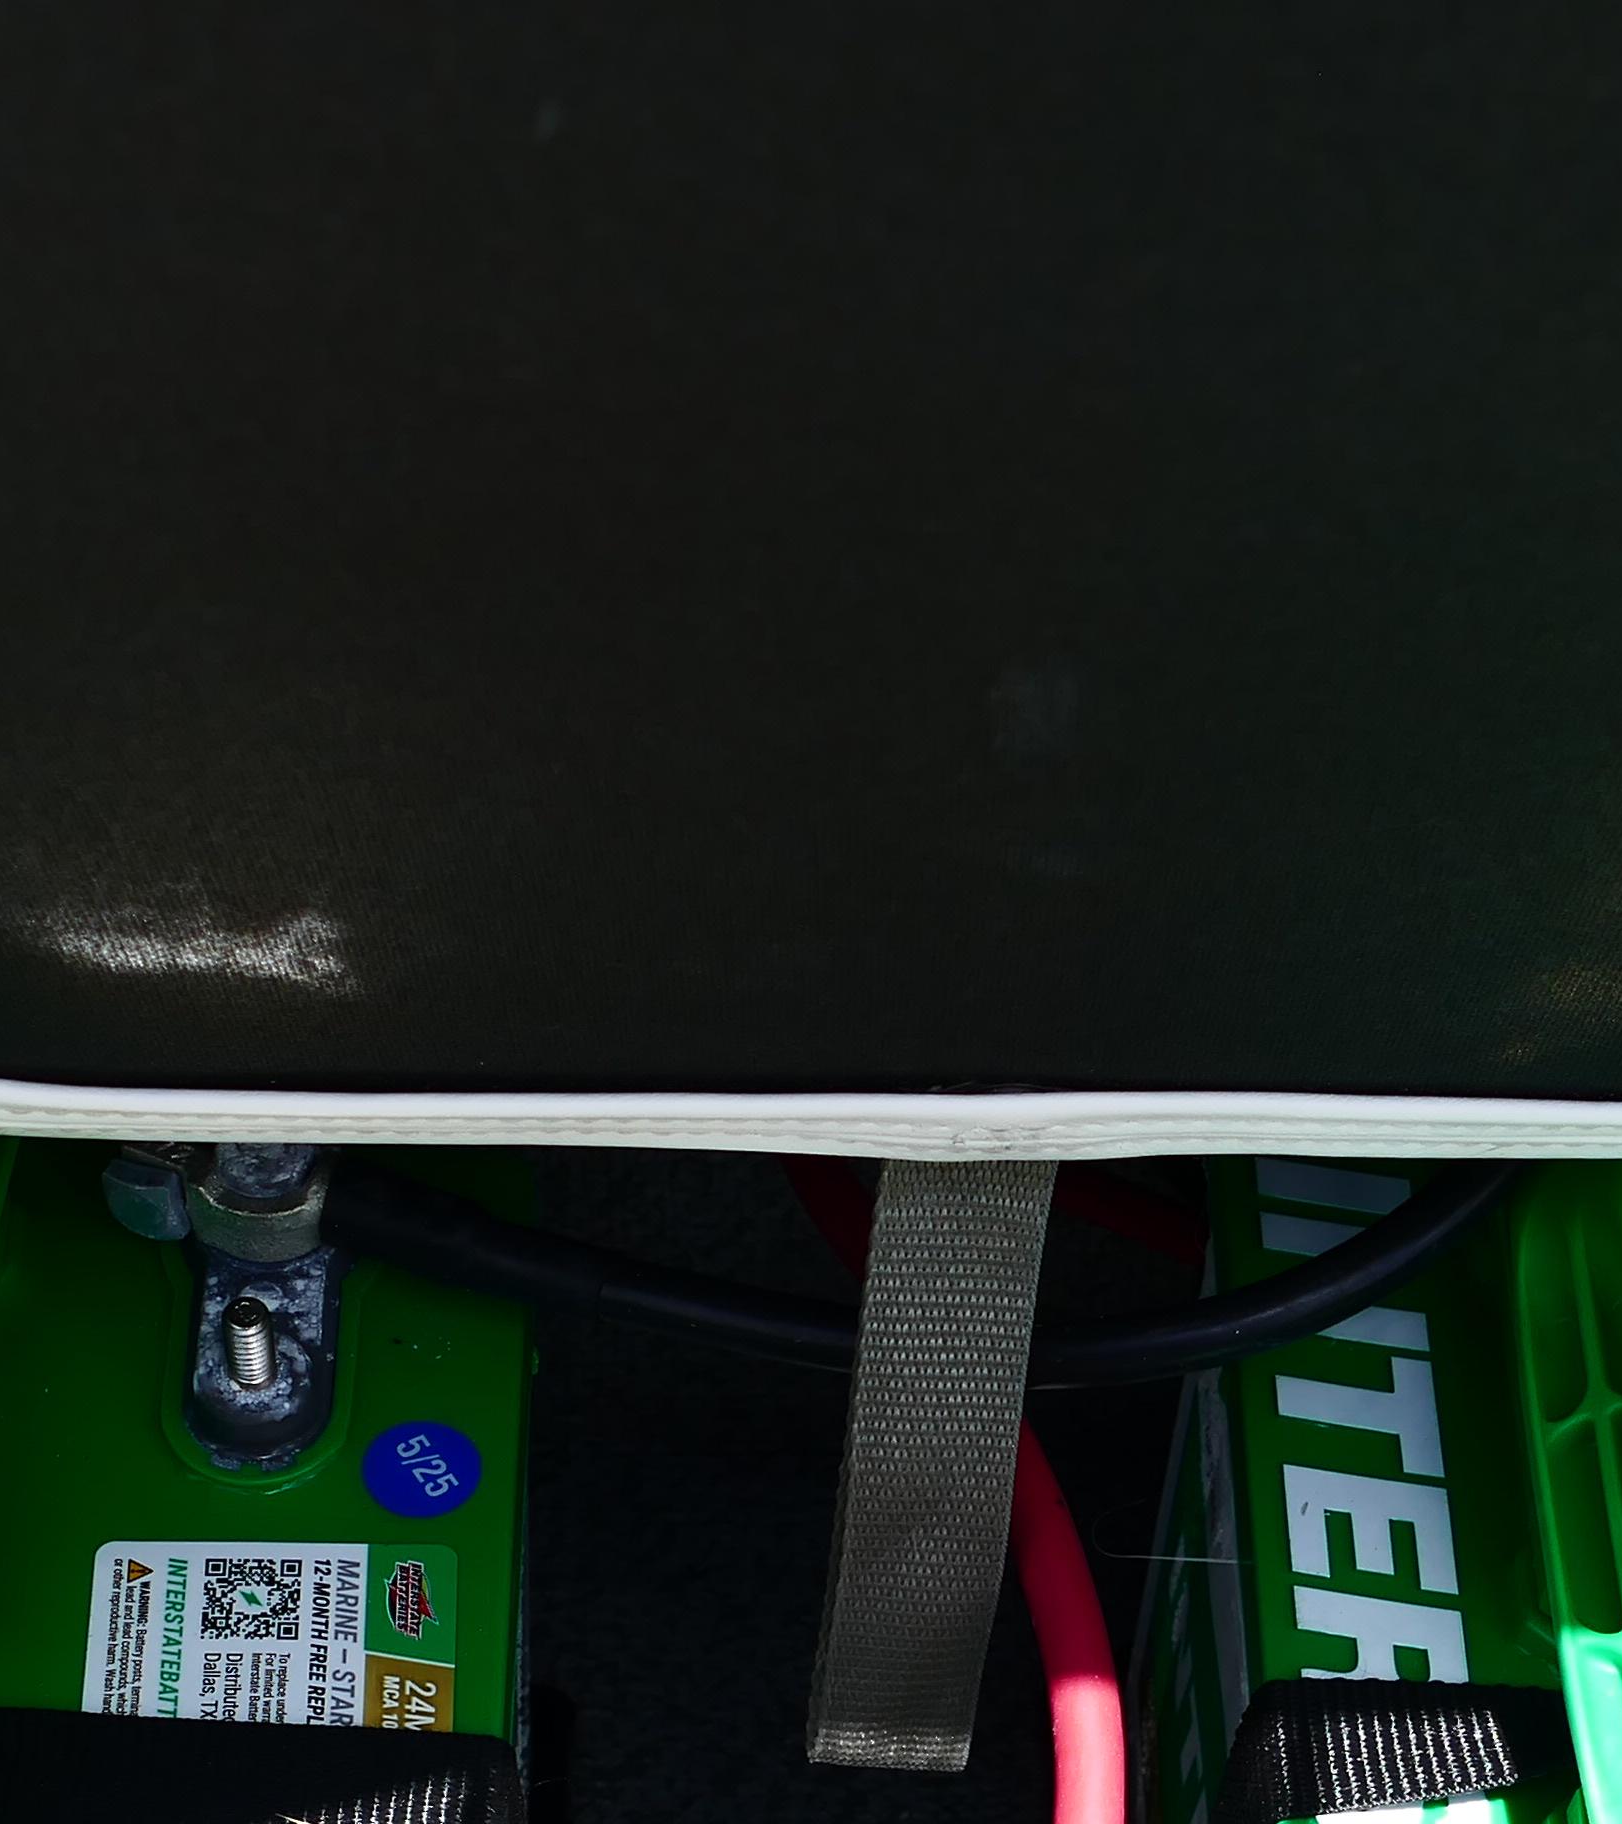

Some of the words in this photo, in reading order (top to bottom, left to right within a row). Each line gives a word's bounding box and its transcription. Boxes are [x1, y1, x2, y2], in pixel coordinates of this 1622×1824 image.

[396, 1434, 459, 1497] 5/25
[112, 1567, 124, 1589] other
[126, 1586, 137, 1603] lead
[137, 1581, 151, 1627] WARNING:
[310, 1559, 331, 1641] 12-MONTH
[334, 1559, 360, 1643] MARINE
[108, 1590, 121, 1643] reproductive
[124, 1604, 134, 1620] and
[123, 1622, 134, 1639] lead
[132, 1629, 147, 1660] Battery
[249, 1653, 262, 1693] Interstate
[265, 1653, 276, 1666] For
[279, 1653, 290, 1663] To
[309, 1644, 328, 1683] FREE
[103, 1669, 117, 1692] Wash
[199, 1653, 222, 1696] Dallas,
[263, 1668, 275, 1698] limited
[276, 1665, 288, 1697] replace
[383, 1675, 400, 1709] MCA
[200, 1701, 218, 1719] TX
